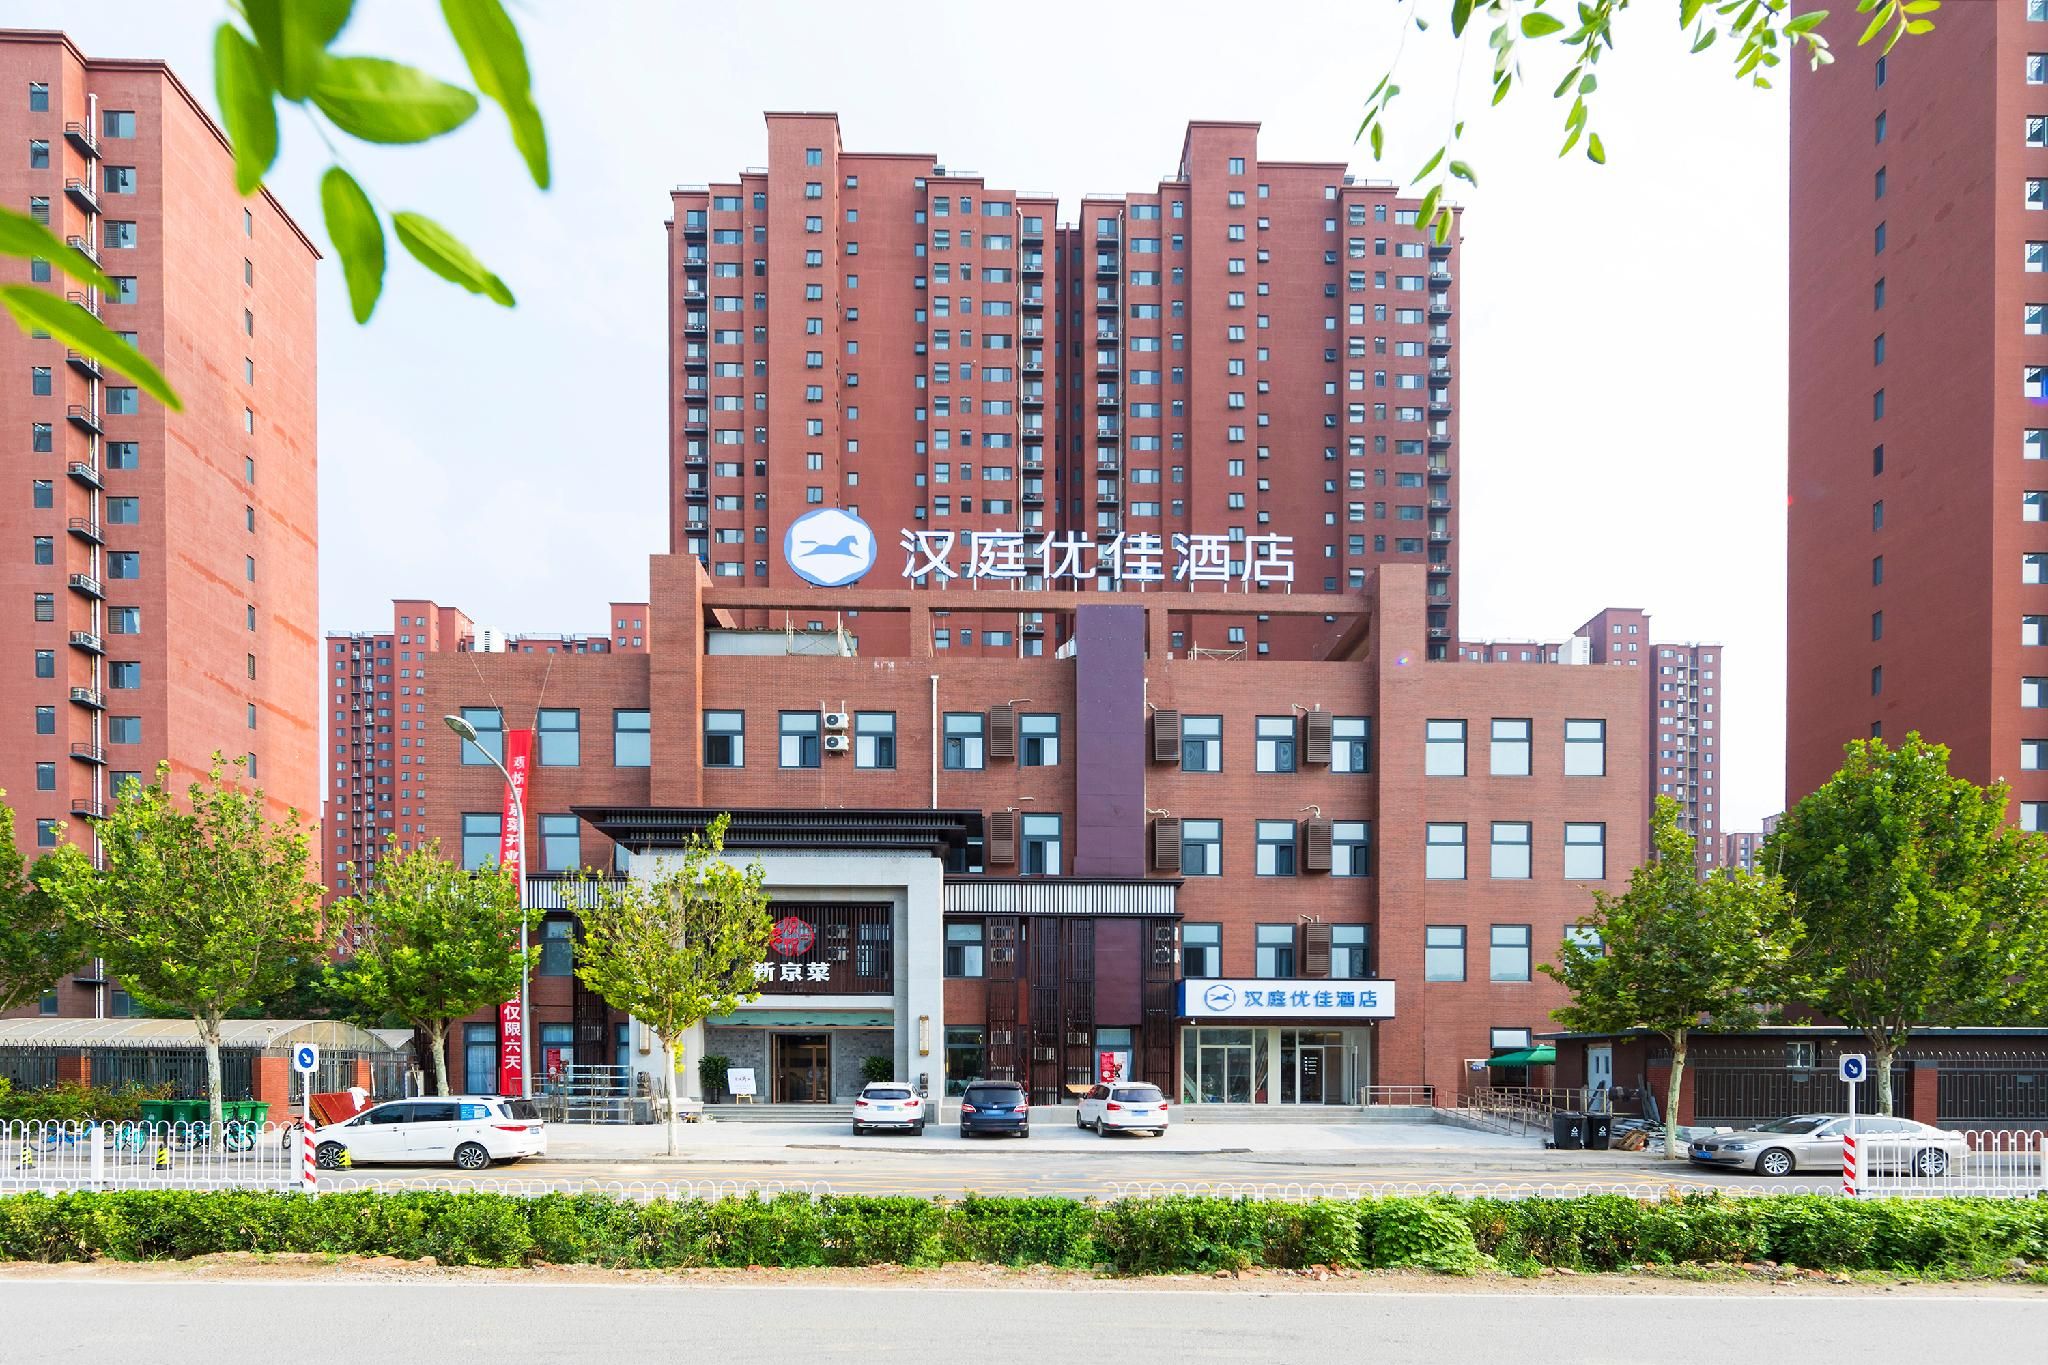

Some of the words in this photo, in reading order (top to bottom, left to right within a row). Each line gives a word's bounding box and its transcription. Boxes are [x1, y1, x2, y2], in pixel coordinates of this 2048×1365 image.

[899, 527, 1295, 582] 汉庭优佳酒店
[752, 961, 831, 982] 新京菜
[1244, 989, 1378, 1008] 汉庭优佳酒店
